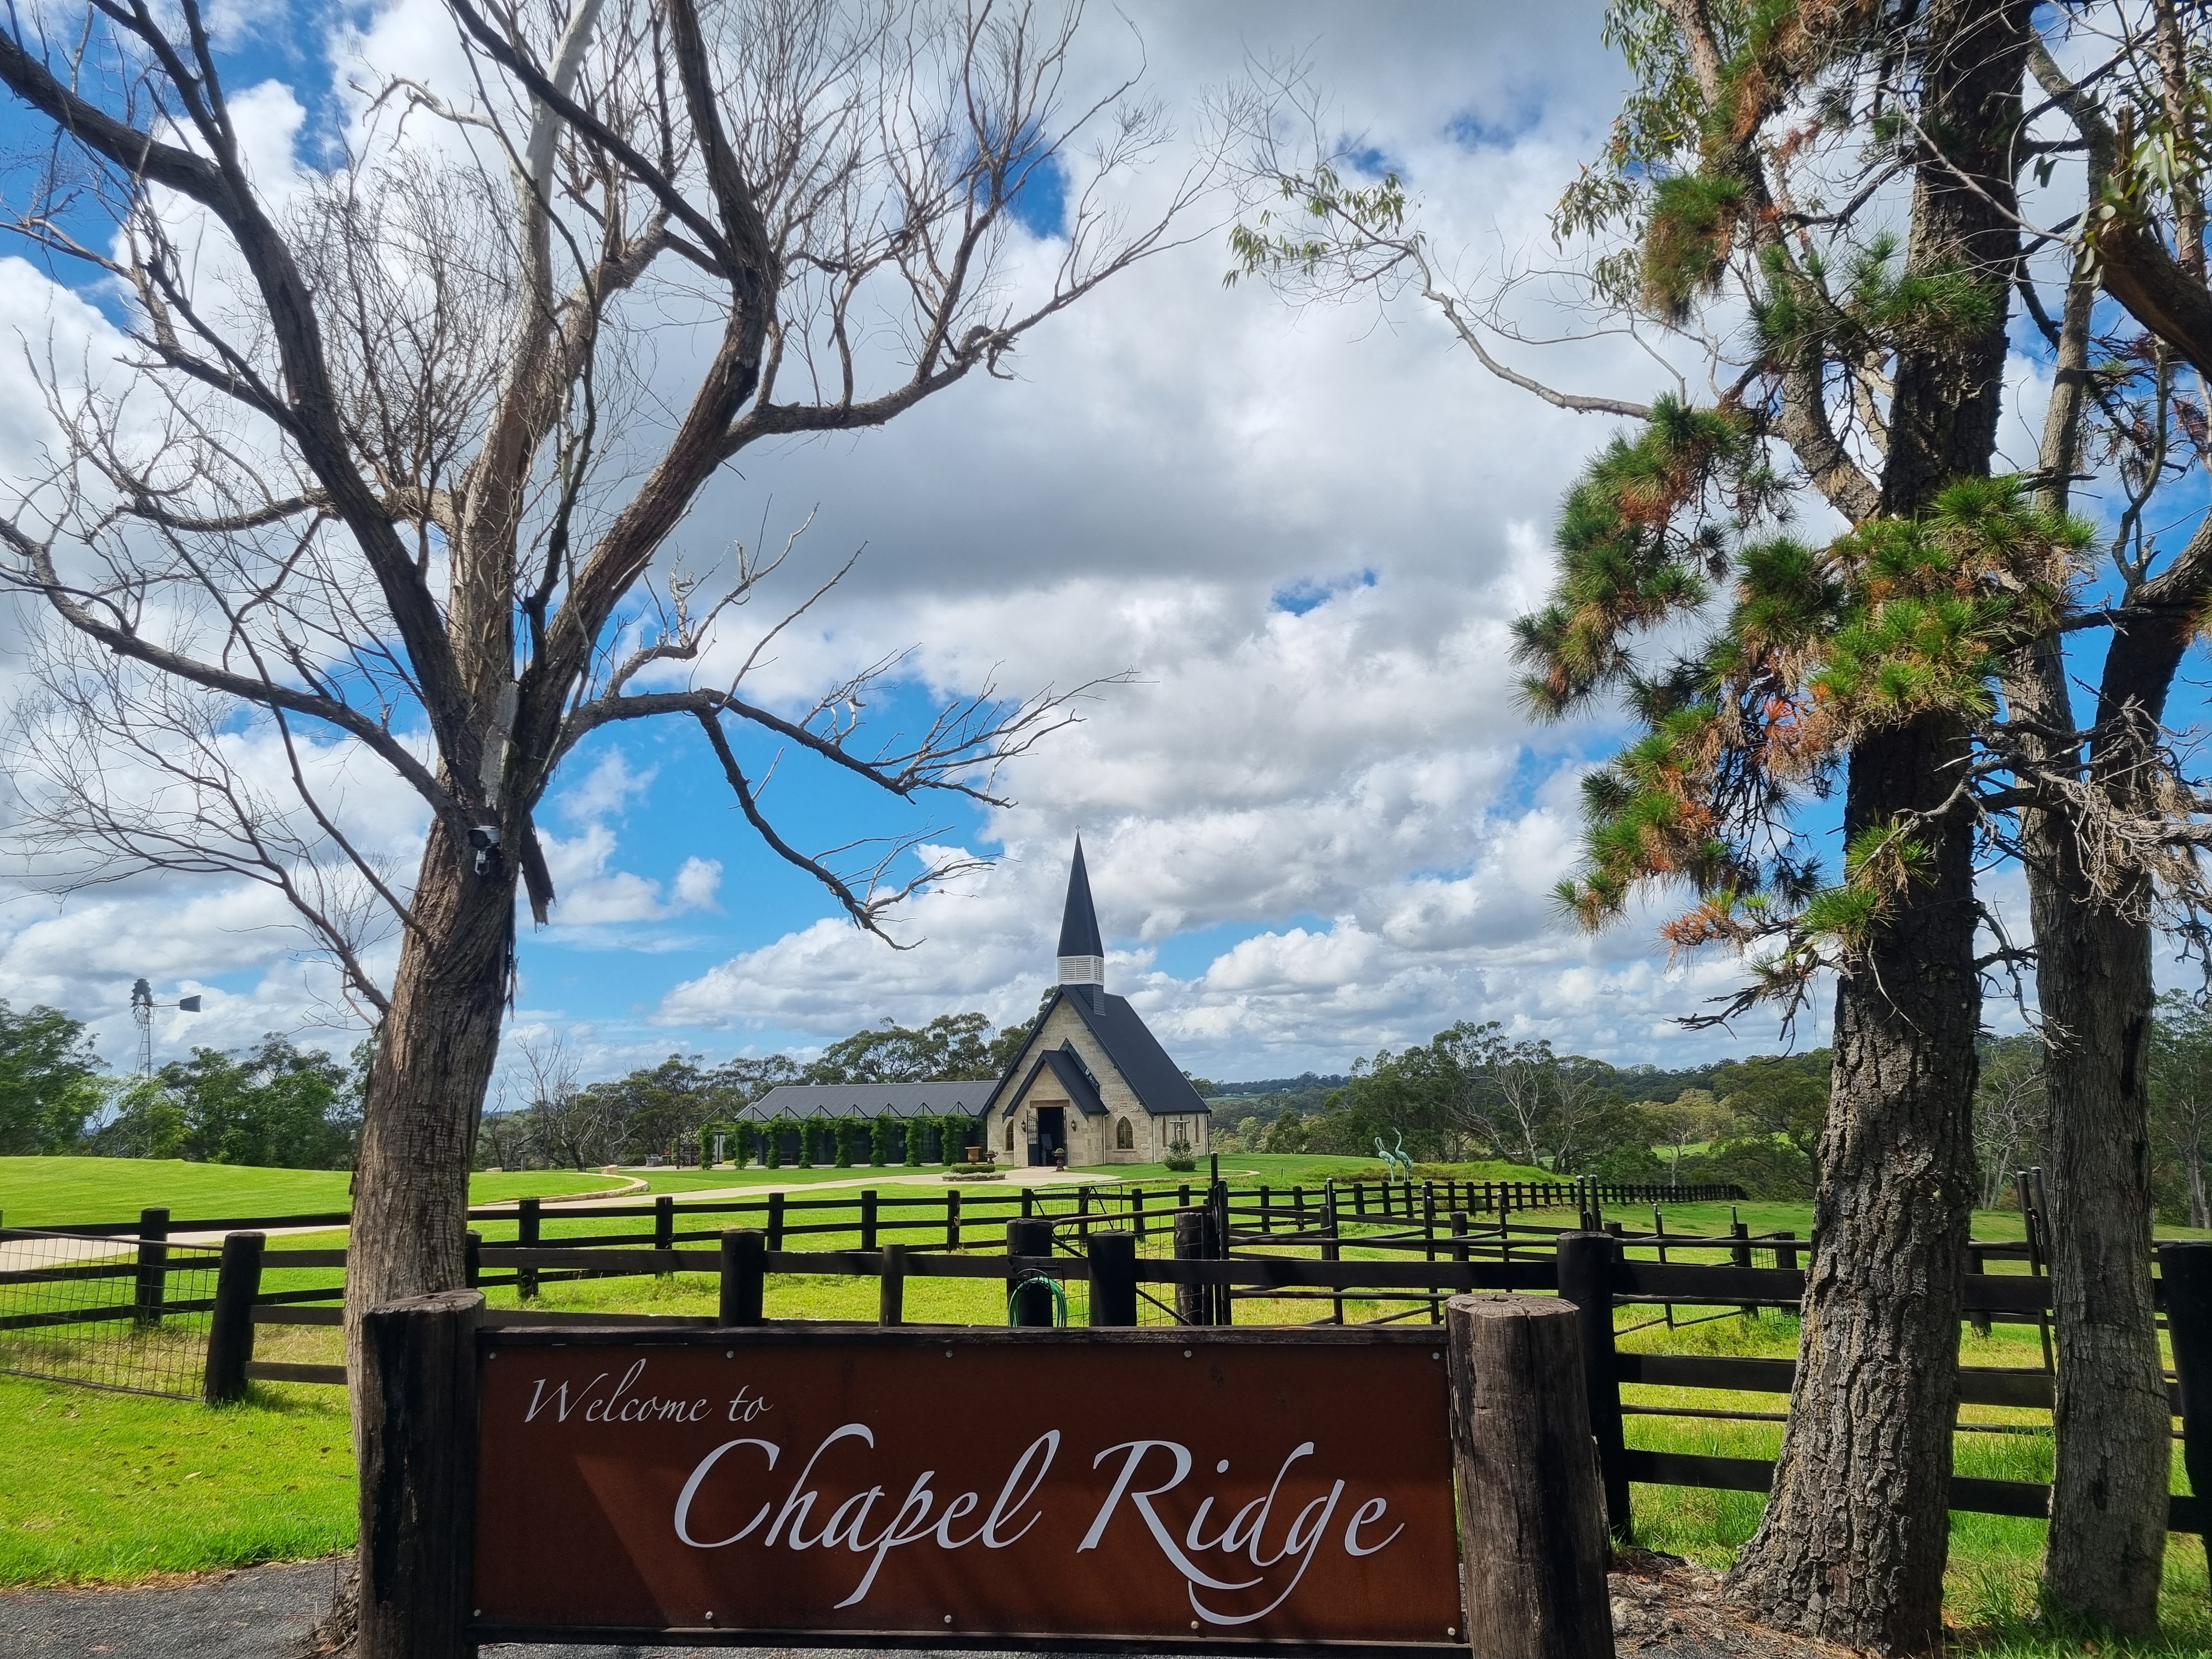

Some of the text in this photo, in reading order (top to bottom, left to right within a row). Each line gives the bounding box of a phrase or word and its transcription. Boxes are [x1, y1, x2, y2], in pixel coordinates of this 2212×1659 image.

[524, 1358, 772, 1423] Welcome to
[674, 1423, 1405, 1626] Chapel Ridge
